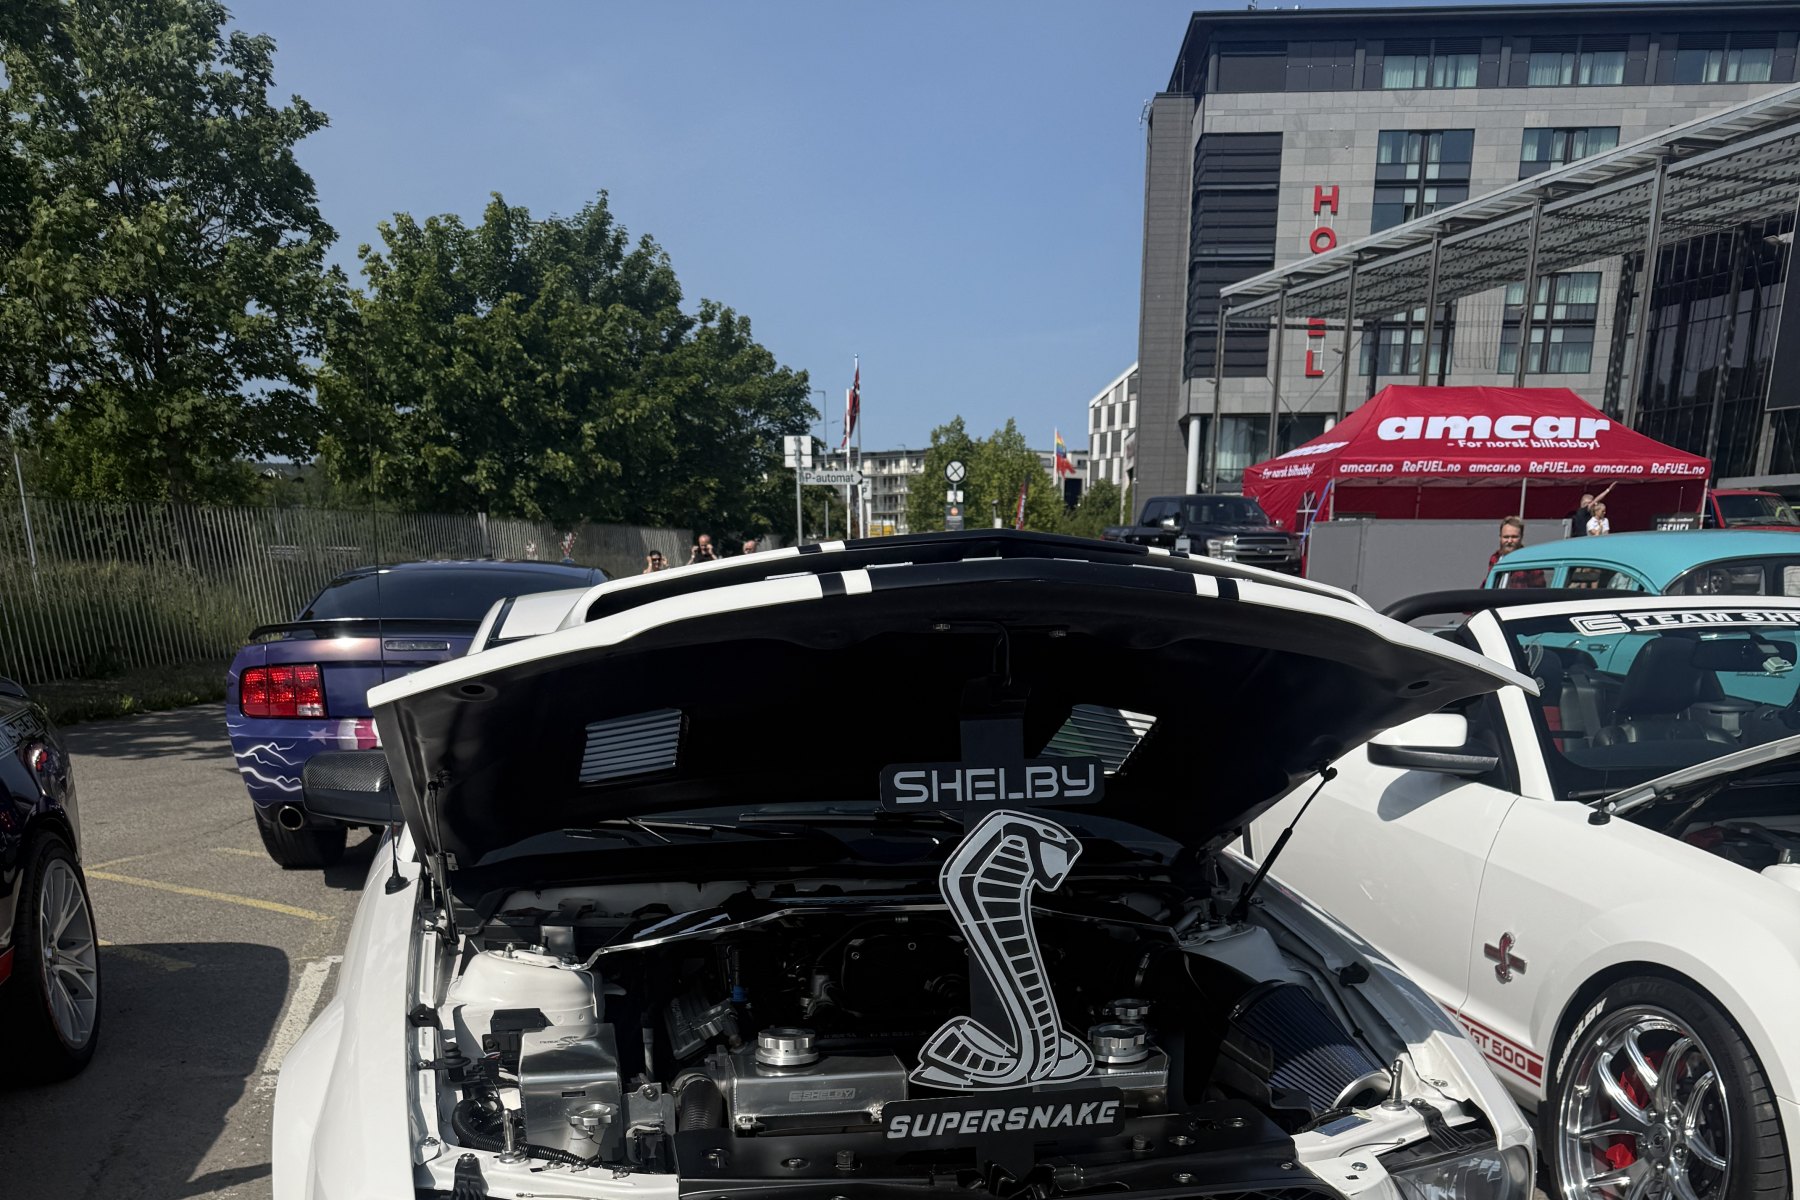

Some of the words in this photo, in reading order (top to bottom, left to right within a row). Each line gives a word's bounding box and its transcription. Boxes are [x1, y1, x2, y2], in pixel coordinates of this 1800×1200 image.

[1377, 415, 1611, 440] amcar
[1458, 439, 1483, 449] For
[1486, 439, 1529, 448] norsk
[1531, 439, 1601, 450] bilhobby!
[805, 472, 855, 483] P-automat
[1339, 463, 1394, 473] amcar.no
[1401, 460, 1461, 473] ReFUEL.no
[1468, 462, 1521, 473] amcar.no
[1528, 461, 1586, 474] ReFUEL.no
[1592, 462, 1644, 474] amcar.no
[1650, 462, 1706, 475] ReFUEL.no
[893, 764, 1095, 803] SHELBY
[1491, 1039, 1526, 1071] 500
[887, 1100, 1119, 1139] SUPERSNAKE
